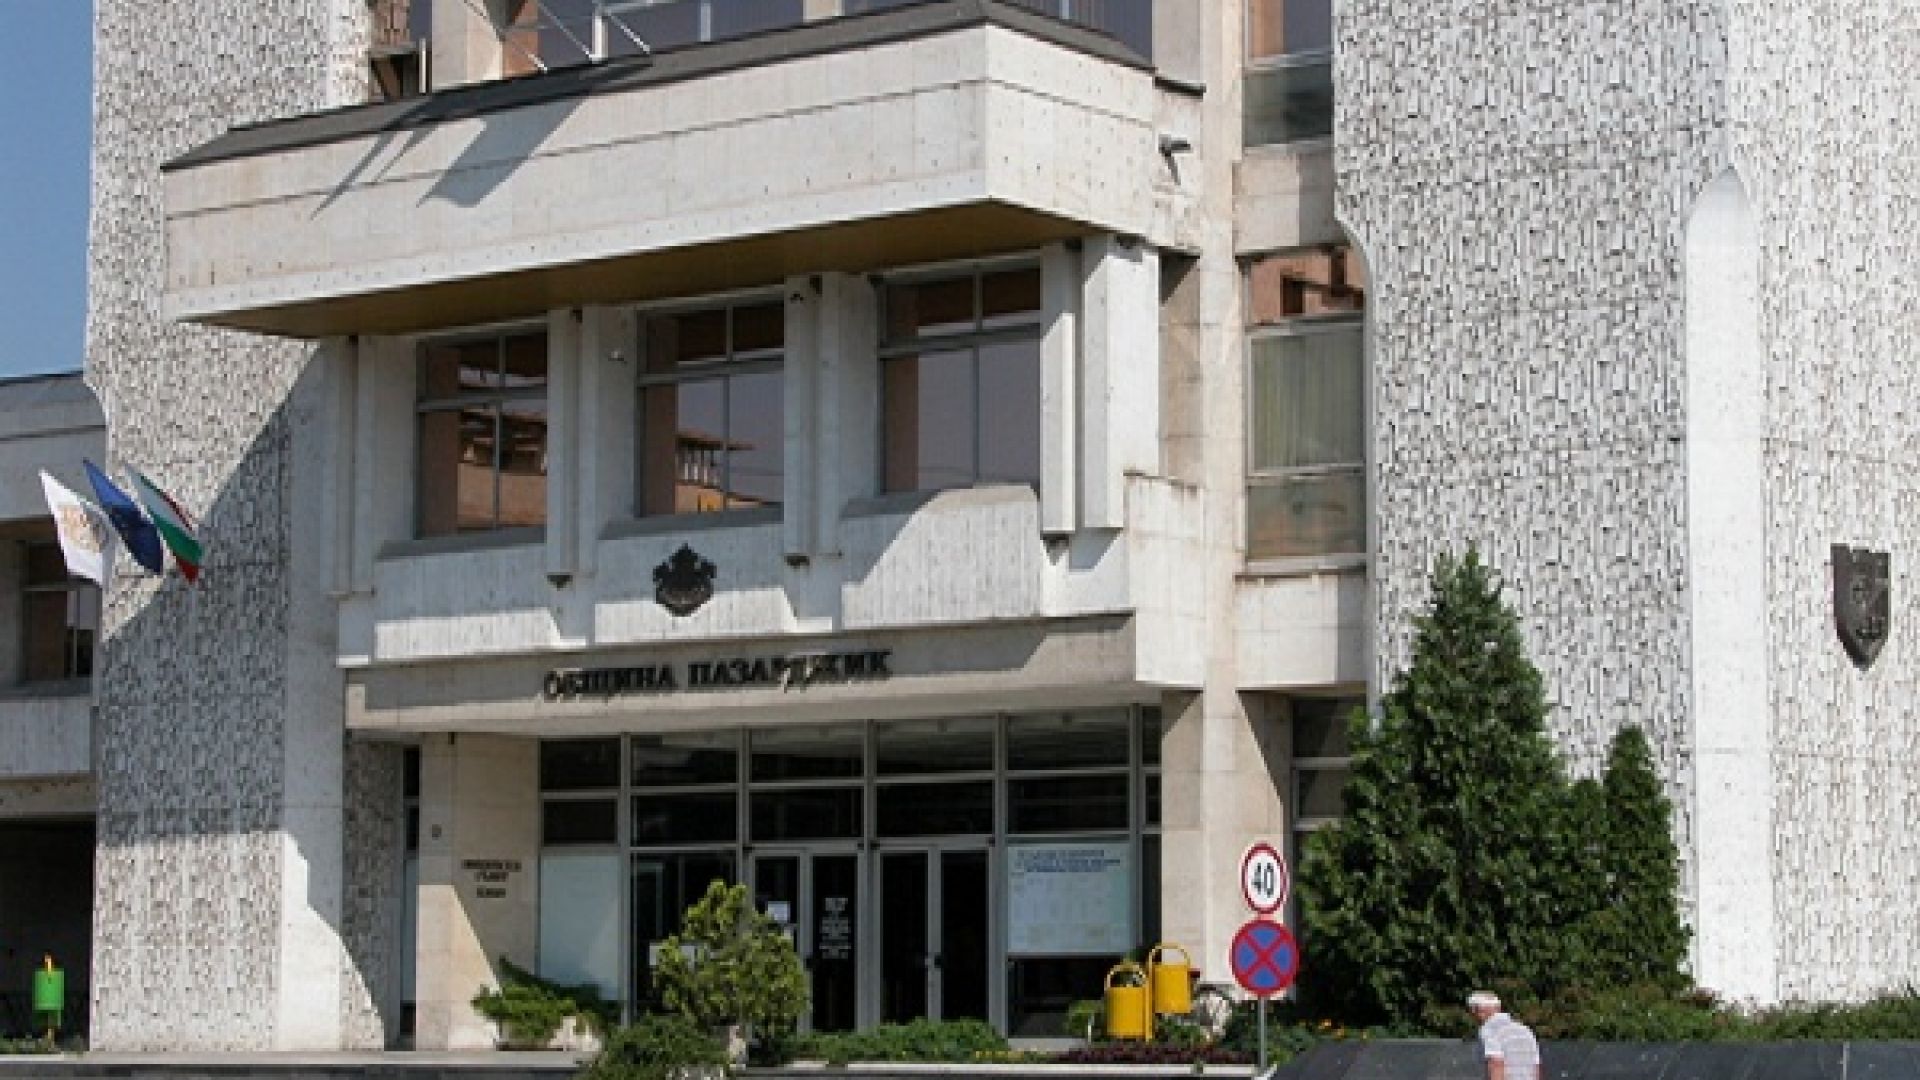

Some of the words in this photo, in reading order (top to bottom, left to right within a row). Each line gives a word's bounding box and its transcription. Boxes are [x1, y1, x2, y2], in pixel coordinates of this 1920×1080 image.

[544, 664, 676, 702] ОБЩИНА
[688, 649, 893, 693] ПАЗАРДЖИК
[1251, 862, 1275, 898] 40
